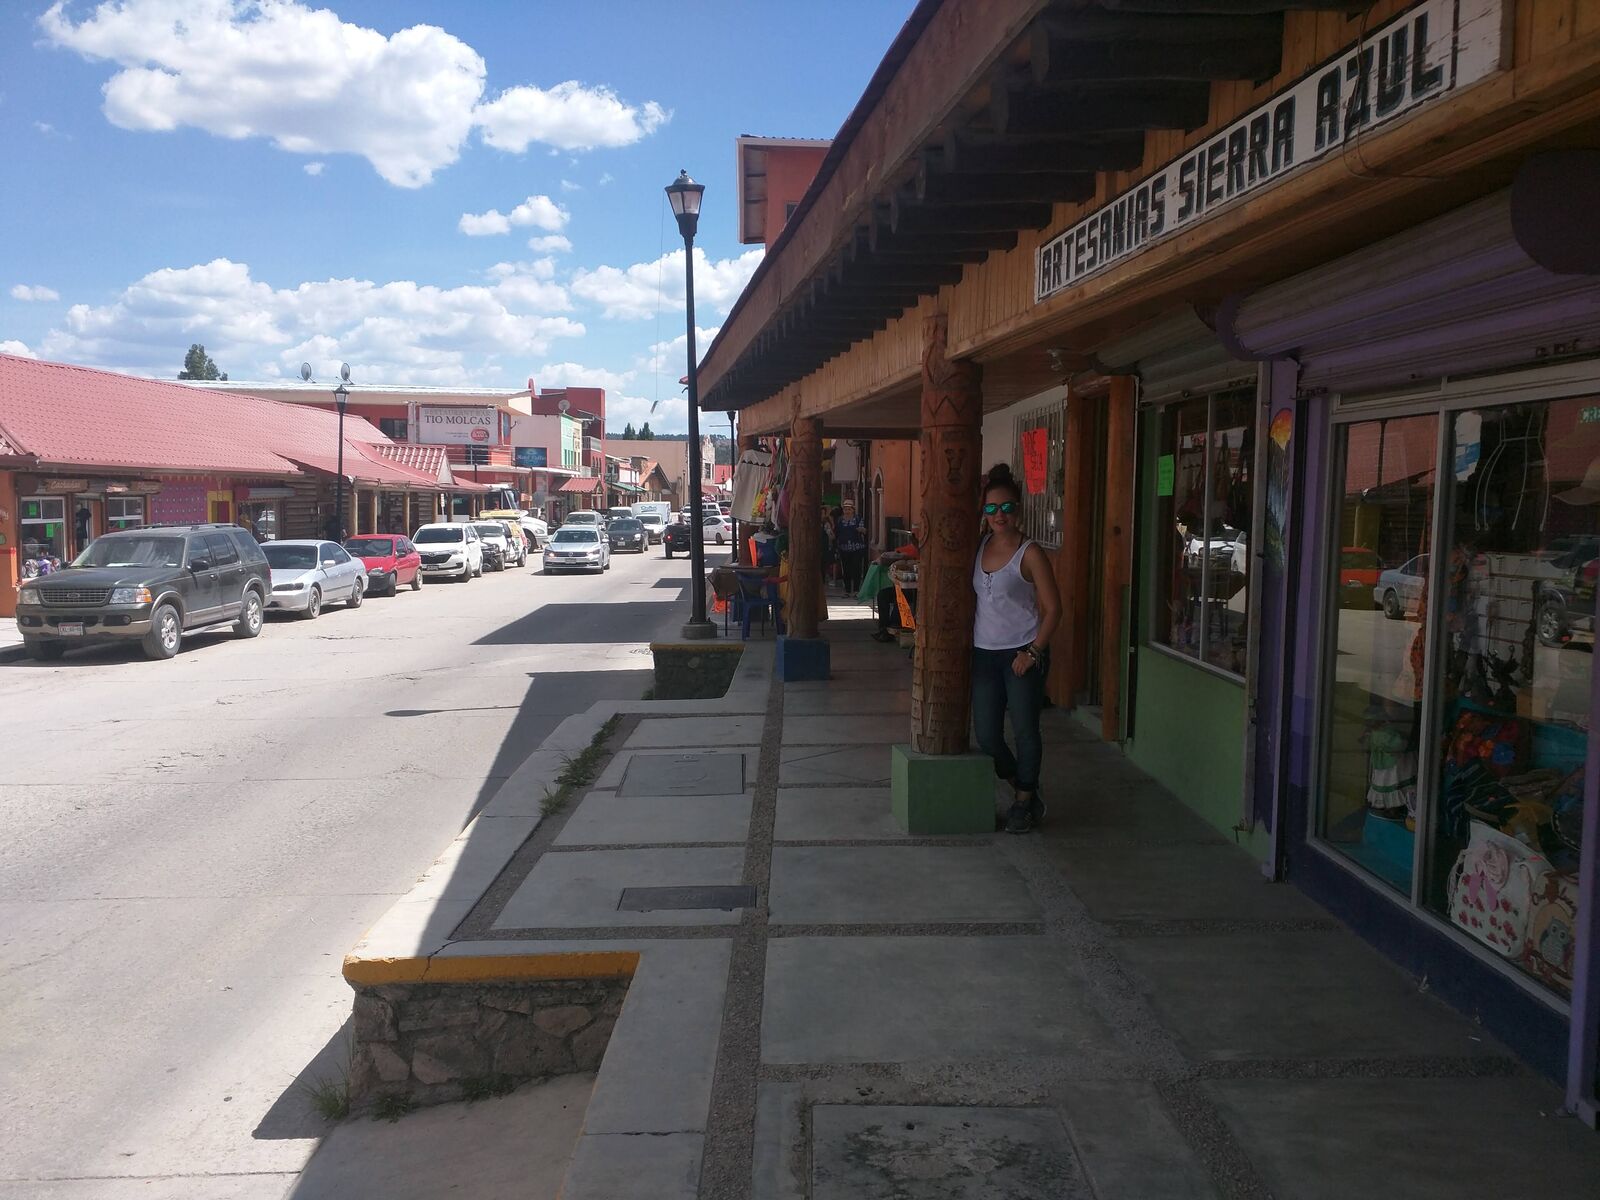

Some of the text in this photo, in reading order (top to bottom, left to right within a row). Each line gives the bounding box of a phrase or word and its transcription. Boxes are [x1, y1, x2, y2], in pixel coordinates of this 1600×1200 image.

[1041, 11, 1444, 294] ARTESANIAS SIERRA AZUL
[424, 415, 491, 425] TIO MOLCAS
